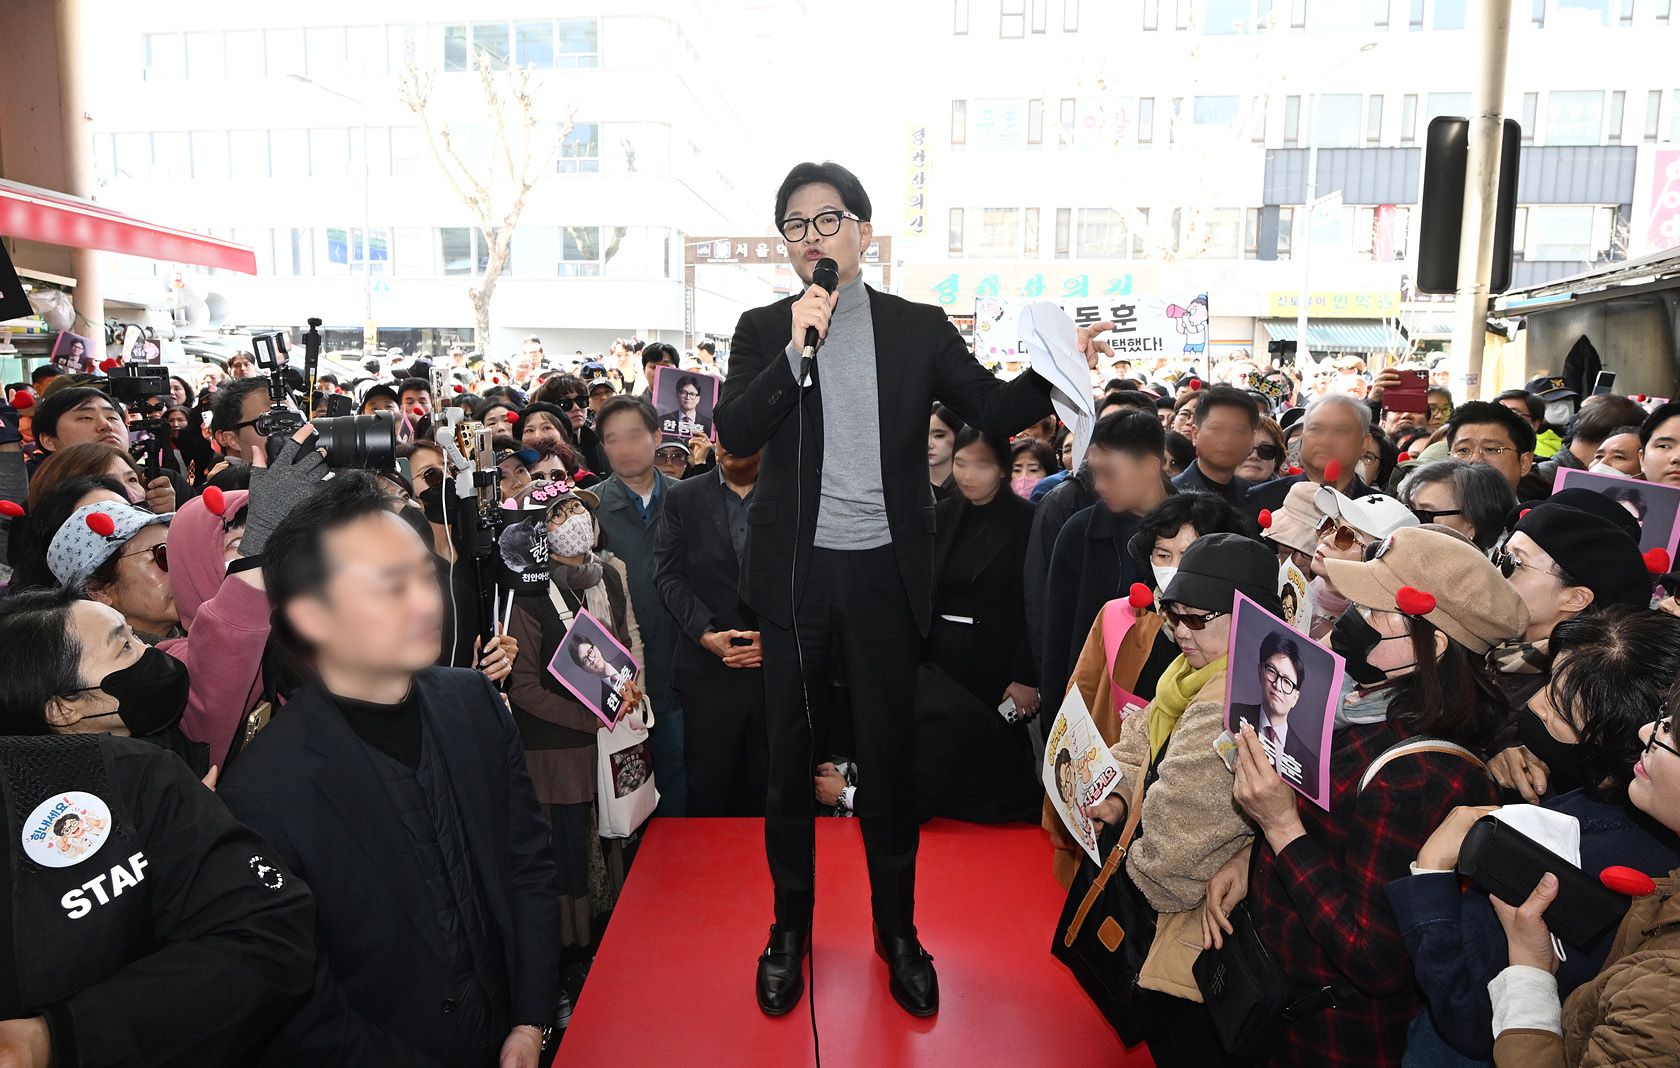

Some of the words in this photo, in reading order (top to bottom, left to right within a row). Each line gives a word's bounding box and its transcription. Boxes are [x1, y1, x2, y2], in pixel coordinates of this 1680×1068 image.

[1061, 304, 1138, 333] 동훈
[1107, 337, 1163, 352] 택했다!
[663, 419, 705, 434] 한동훈
[29, 796, 73, 842] 힘내세요!
